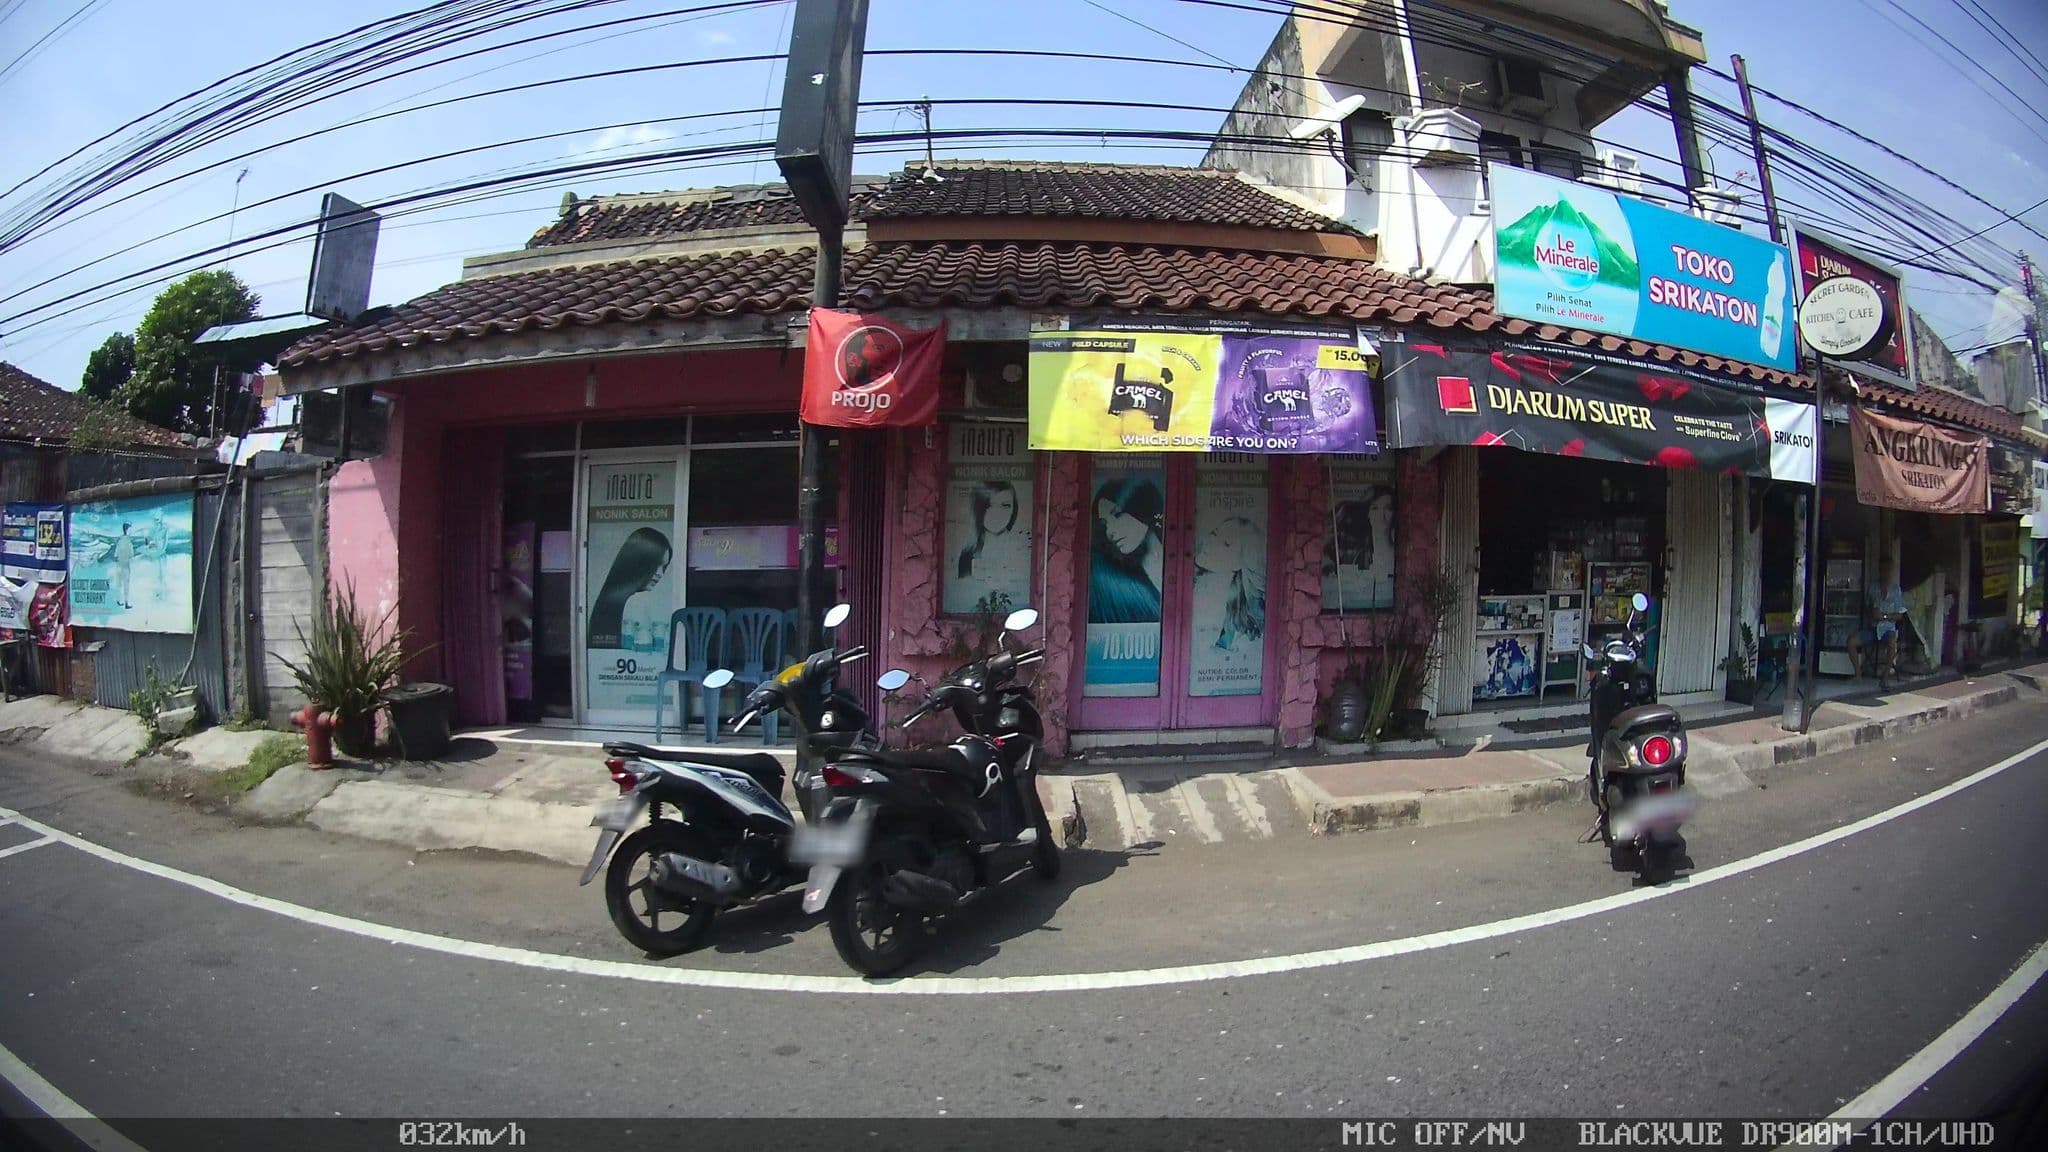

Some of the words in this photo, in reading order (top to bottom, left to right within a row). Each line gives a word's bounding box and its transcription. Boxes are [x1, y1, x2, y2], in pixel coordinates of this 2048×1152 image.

[1557, 233, 1574, 253] Le
[1536, 245, 1598, 273] Minerale
[1671, 245, 1735, 285] TOKO
[1547, 292, 1566, 303] Pilih
[1568, 296, 1592, 308] Sehat
[1648, 276, 1758, 328] SRIKATON
[1809, 284, 1836, 304] SECRET
[1838, 283, 1870, 299] GARDEN
[1535, 303, 1555, 314] Pilih
[1568, 309, 1605, 323] Minerale
[1806, 312, 1835, 324] KITCHEN
[1848, 307, 1874, 320] CAFE
[831, 390, 891, 413] PROJO
[1115, 385, 1162, 401] CAMEL
[1263, 389, 1309, 403] CAMEL
[1487, 384, 1587, 422] DJARUM
[1587, 399, 1657, 431] SUPER
[1685, 426, 1720, 440] Superfine
[1705, 419, 1717, 427] THE
[1717, 421, 1733, 430] TASTE
[1121, 433, 1169, 446] WHICH
[1172, 435, 1205, 447] SIDE
[1208, 436, 1233, 448] ARE
[1236, 437, 1265, 449] YOU
[1901, 469, 1947, 489] SRIKATON
[595, 509, 629, 520] NONIK
[631, 508, 668, 519] SALON
[616, 658, 637, 674] 90
